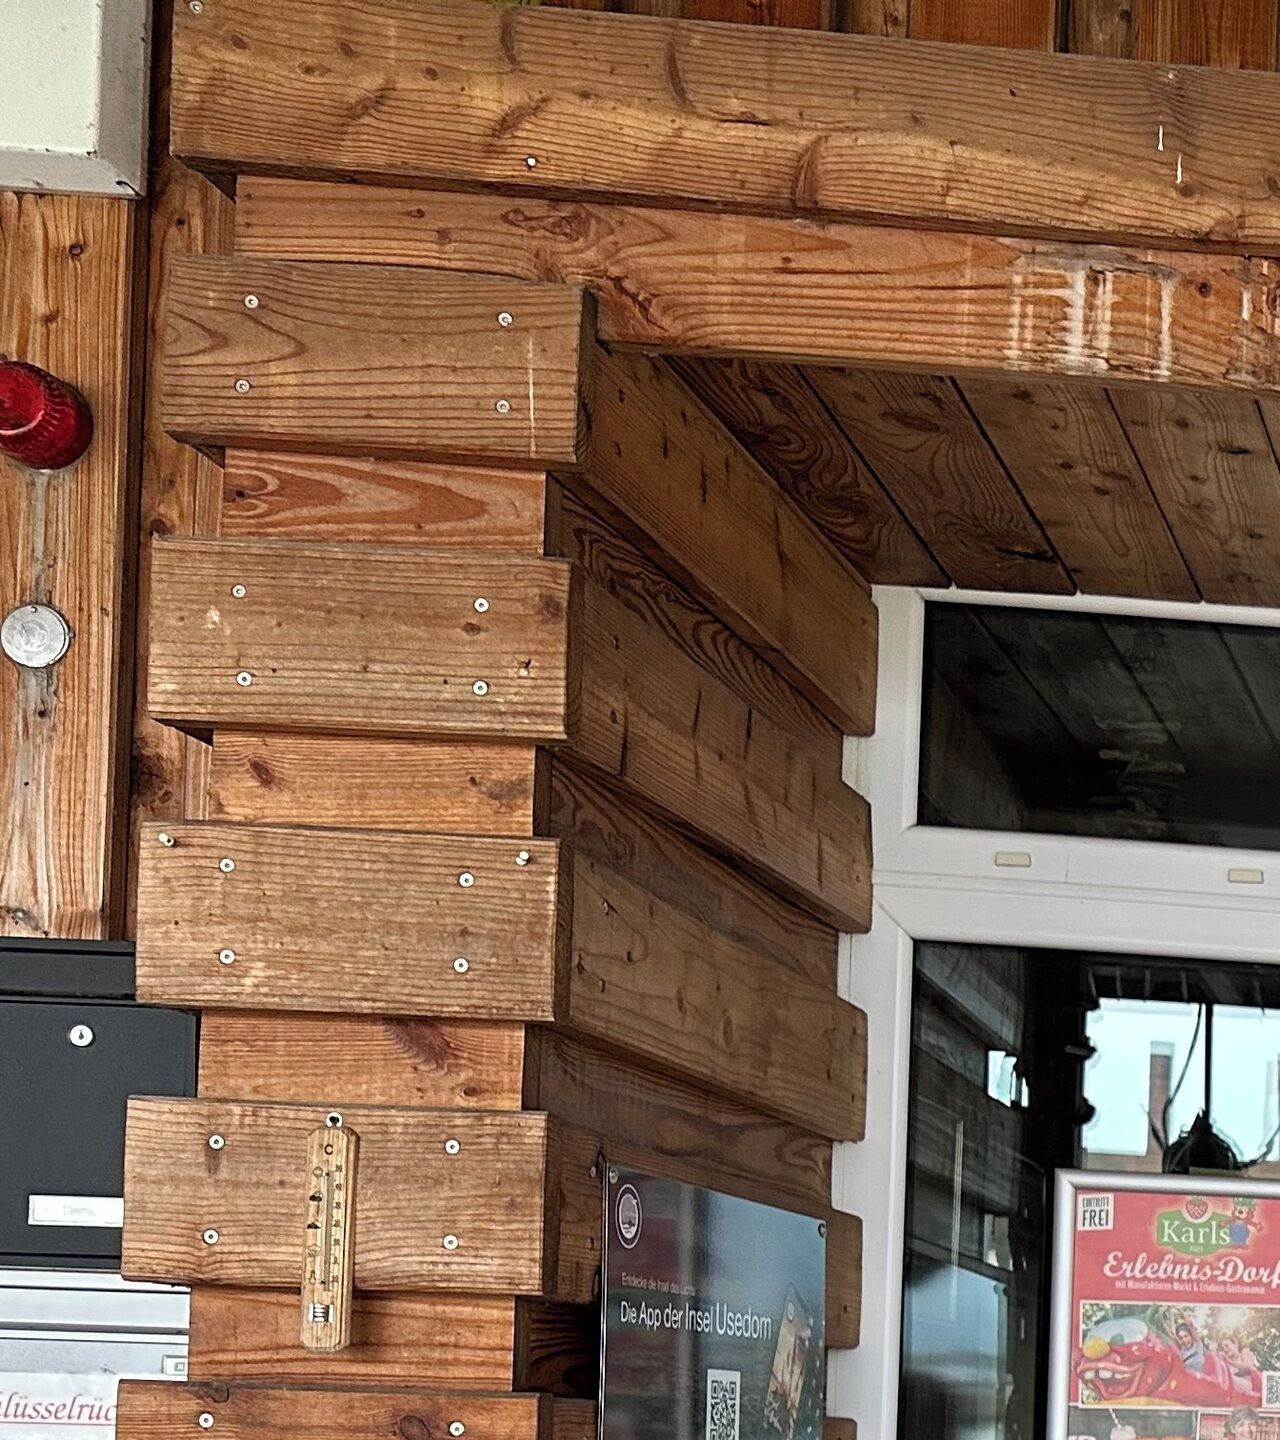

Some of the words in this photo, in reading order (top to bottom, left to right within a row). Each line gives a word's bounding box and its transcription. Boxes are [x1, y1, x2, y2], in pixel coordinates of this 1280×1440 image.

[1083, 1210, 1108, 1227] FREI
[1163, 1220, 1231, 1245] Karls
[621, 1301, 637, 1323] Die
[639, 1301, 661, 1331] App
[664, 1303, 683, 1329] der
[685, 1302, 713, 1332] Insel
[716, 1302, 772, 1340] Usedom
